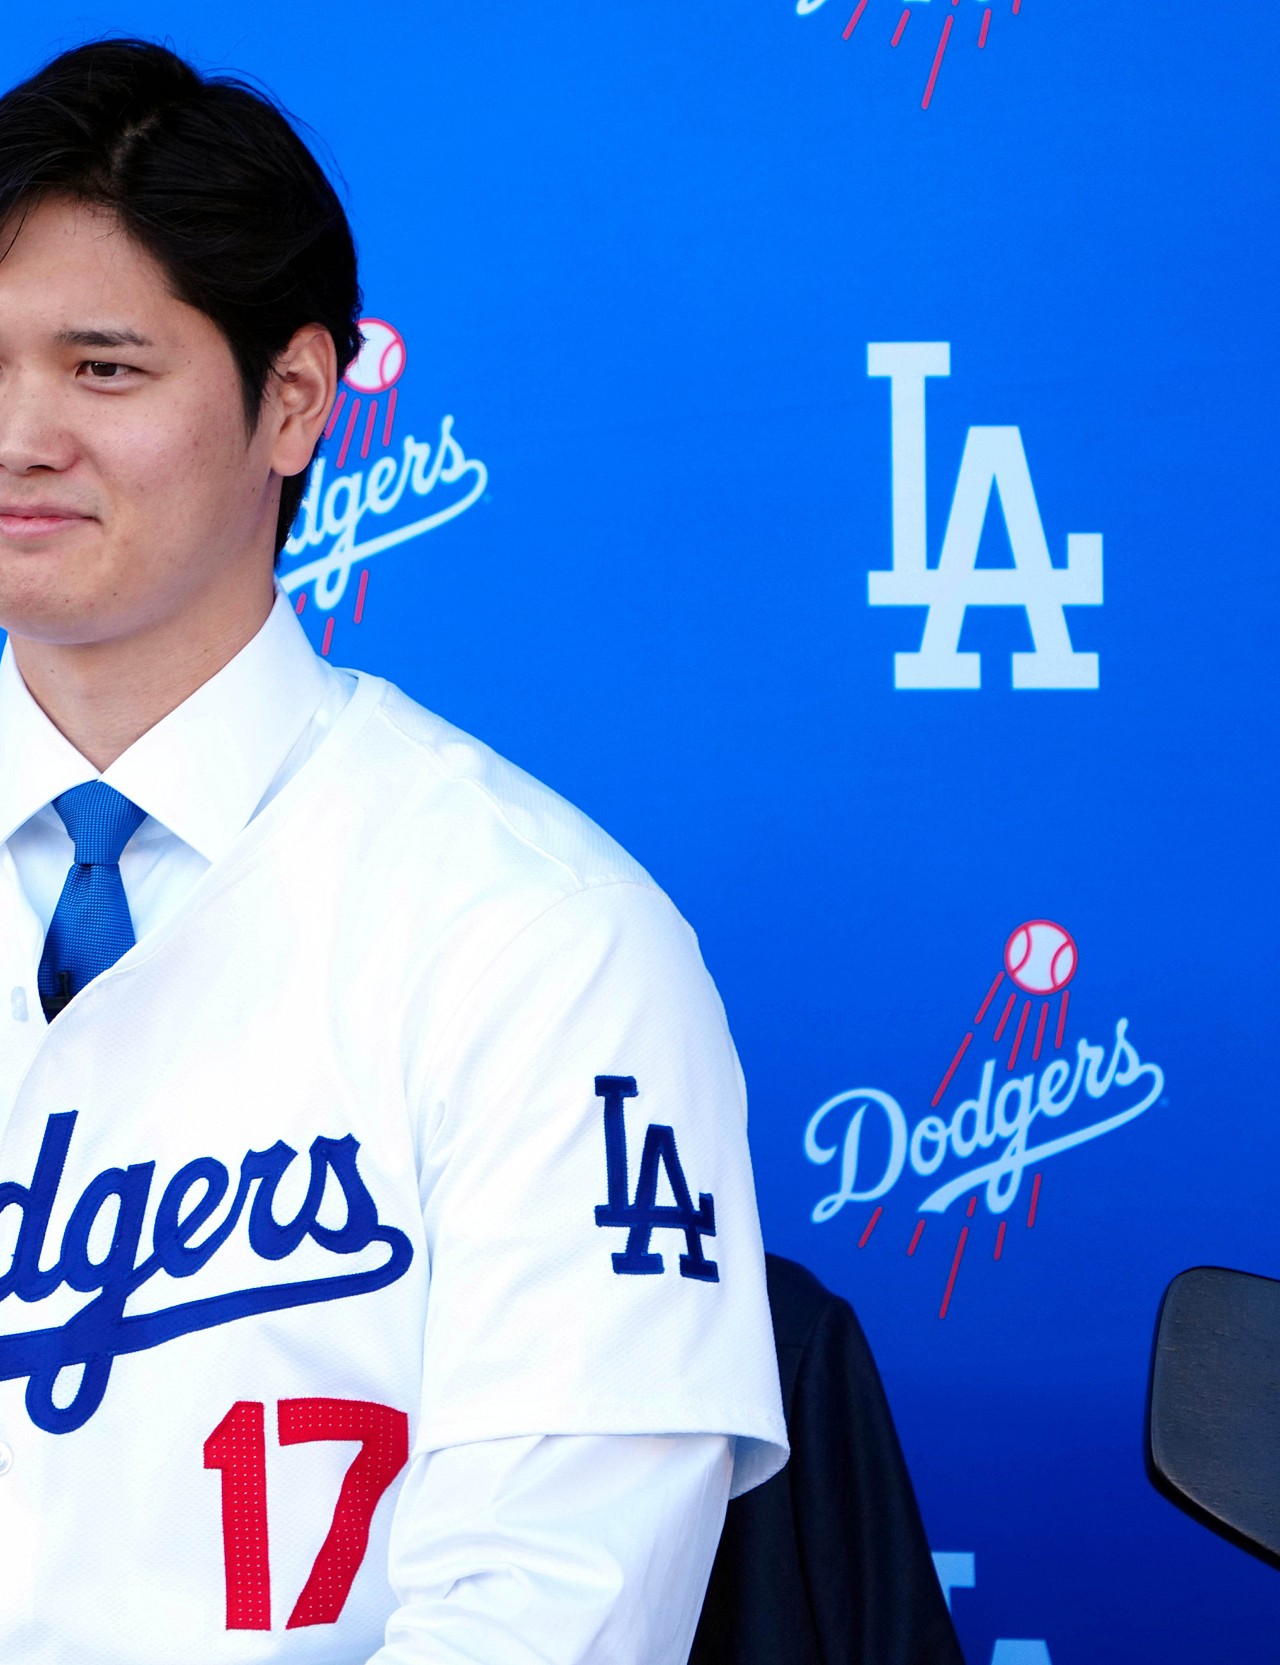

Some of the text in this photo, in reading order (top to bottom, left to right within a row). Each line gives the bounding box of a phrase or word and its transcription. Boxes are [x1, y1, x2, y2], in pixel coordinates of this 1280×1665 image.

[279, 415, 487, 610] dgers
[867, 342, 1103, 689] LA
[594, 1075, 720, 1283] LA
[804, 1018, 1164, 1223] Dodgers
[203, 1397, 409, 1631] 17
